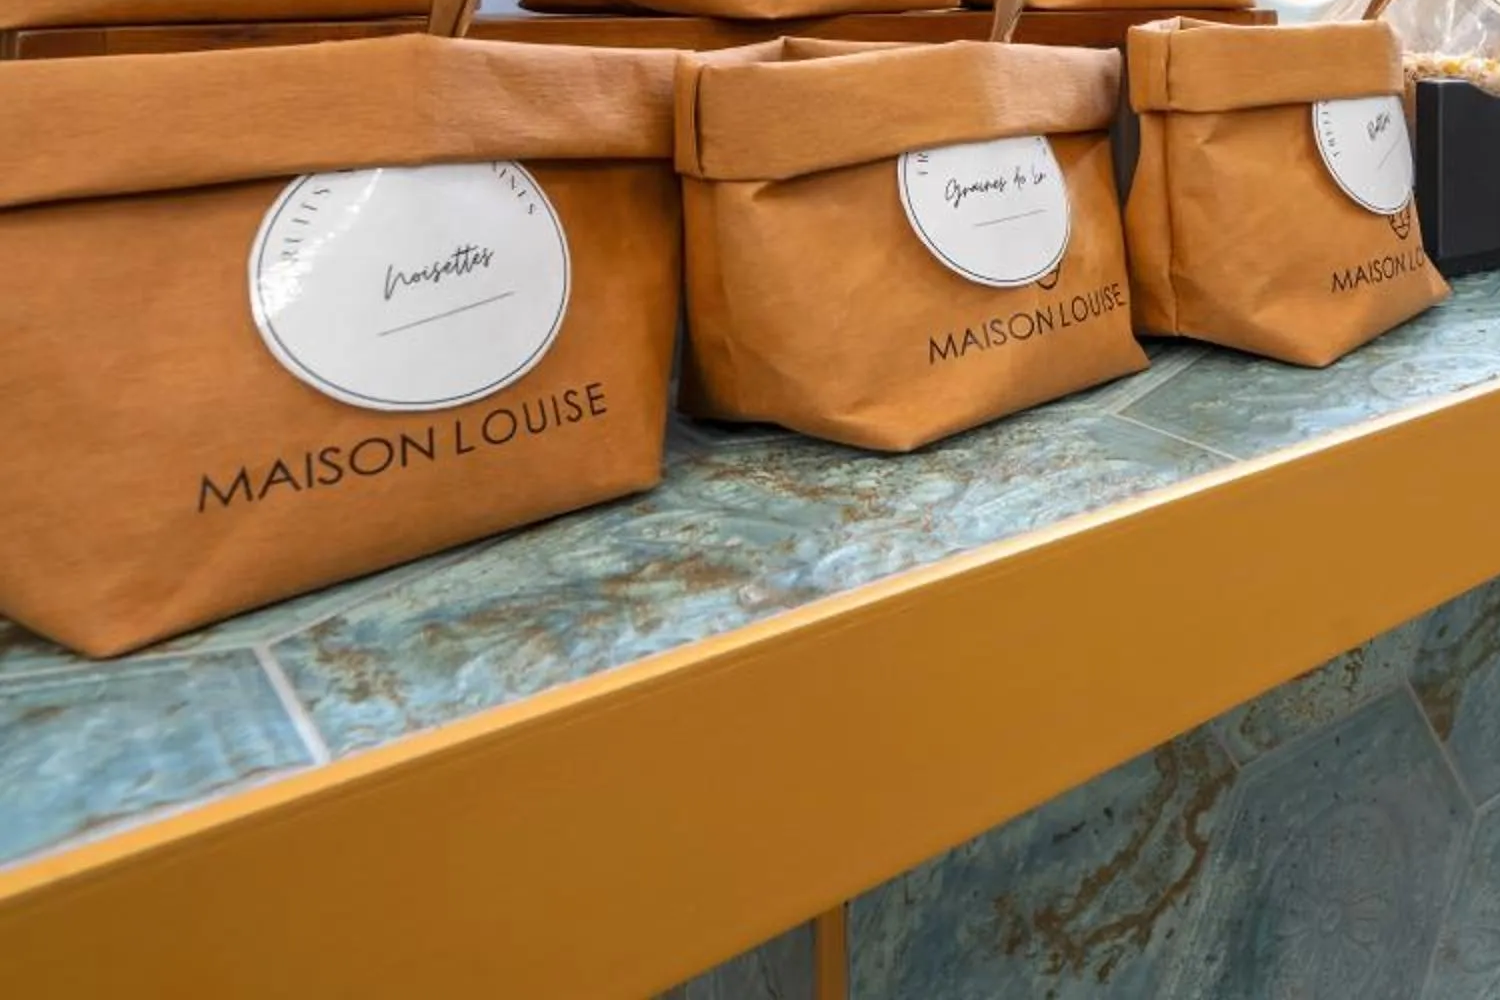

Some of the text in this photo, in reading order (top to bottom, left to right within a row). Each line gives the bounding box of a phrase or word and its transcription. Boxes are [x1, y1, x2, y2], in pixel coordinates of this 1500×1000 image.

[1330, 252, 1407, 294] MAISON
[928, 282, 1128, 365] MAISON LOUISE
[197, 382, 608, 513] MAISON LOUISE
